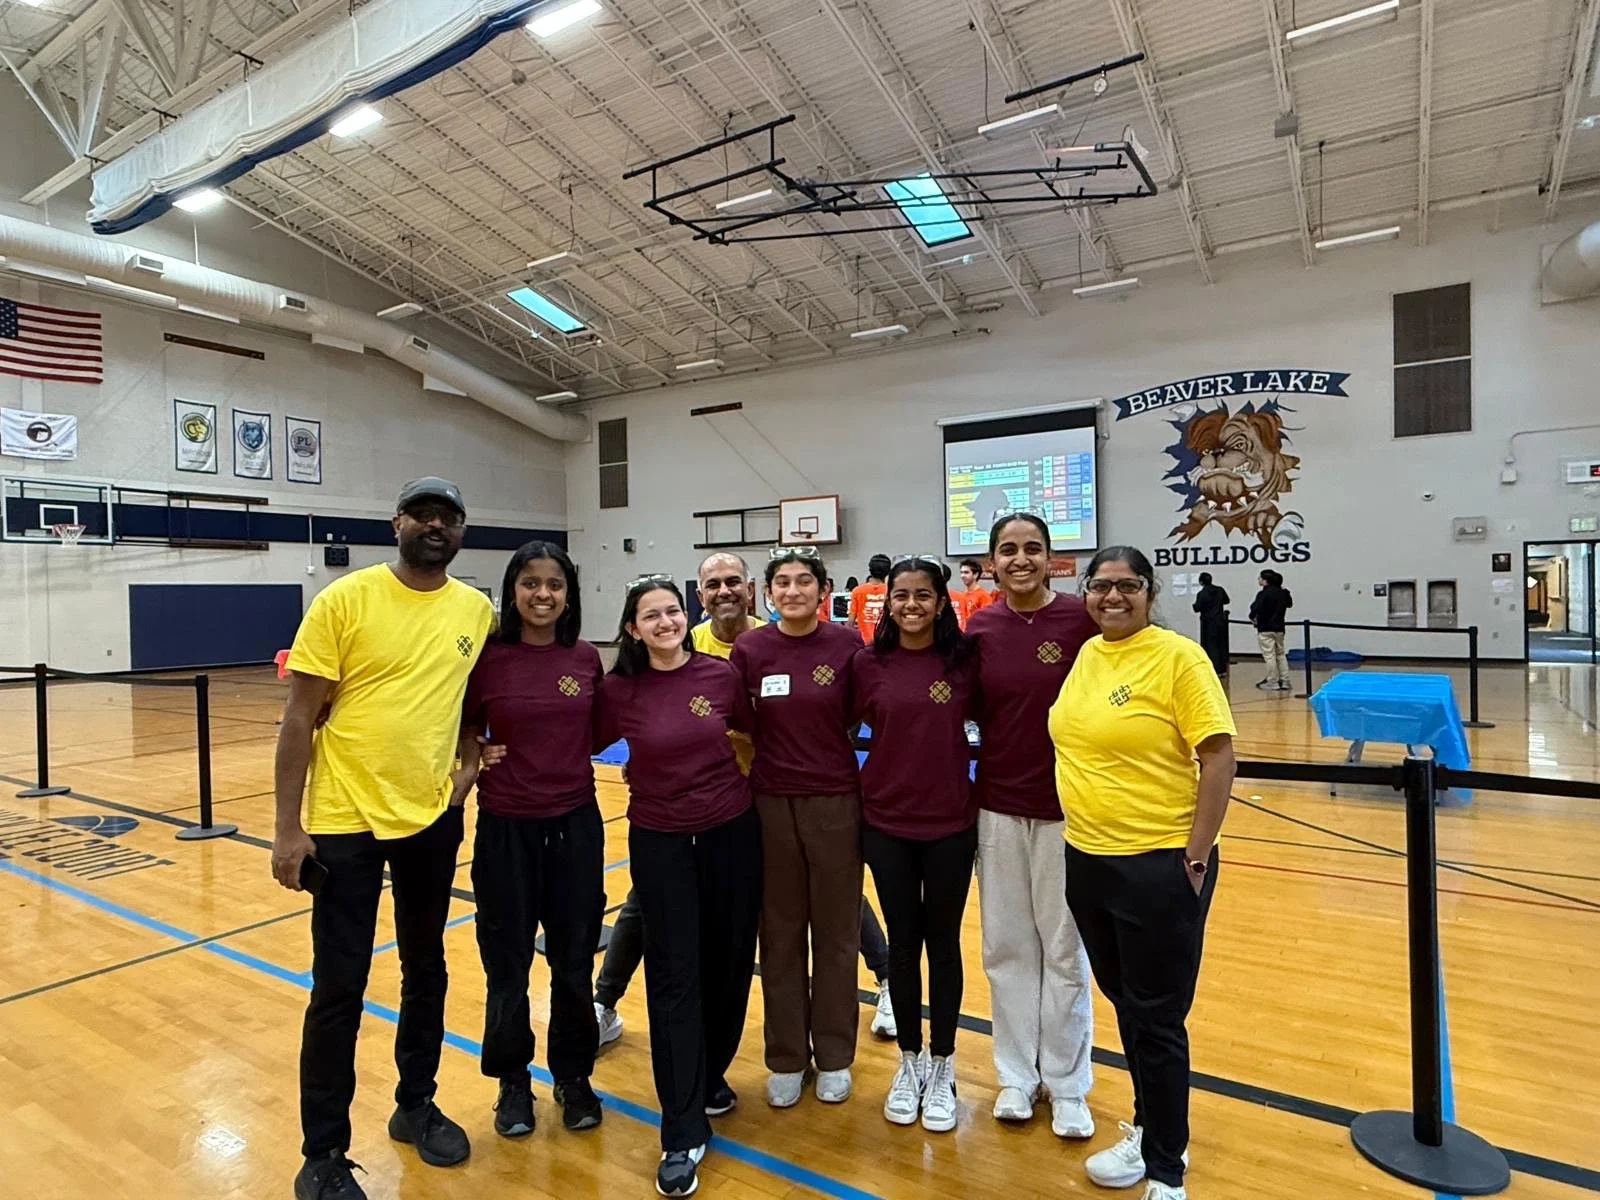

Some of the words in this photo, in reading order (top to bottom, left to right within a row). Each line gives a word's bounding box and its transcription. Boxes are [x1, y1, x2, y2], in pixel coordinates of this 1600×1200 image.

[1128, 375, 1235, 415] BEAVER
[1243, 372, 1331, 393] LAKE
[297, 436, 312, 447] PL
[1154, 541, 1311, 567] BULLDOGS
[22, 839, 176, 881] COURT
